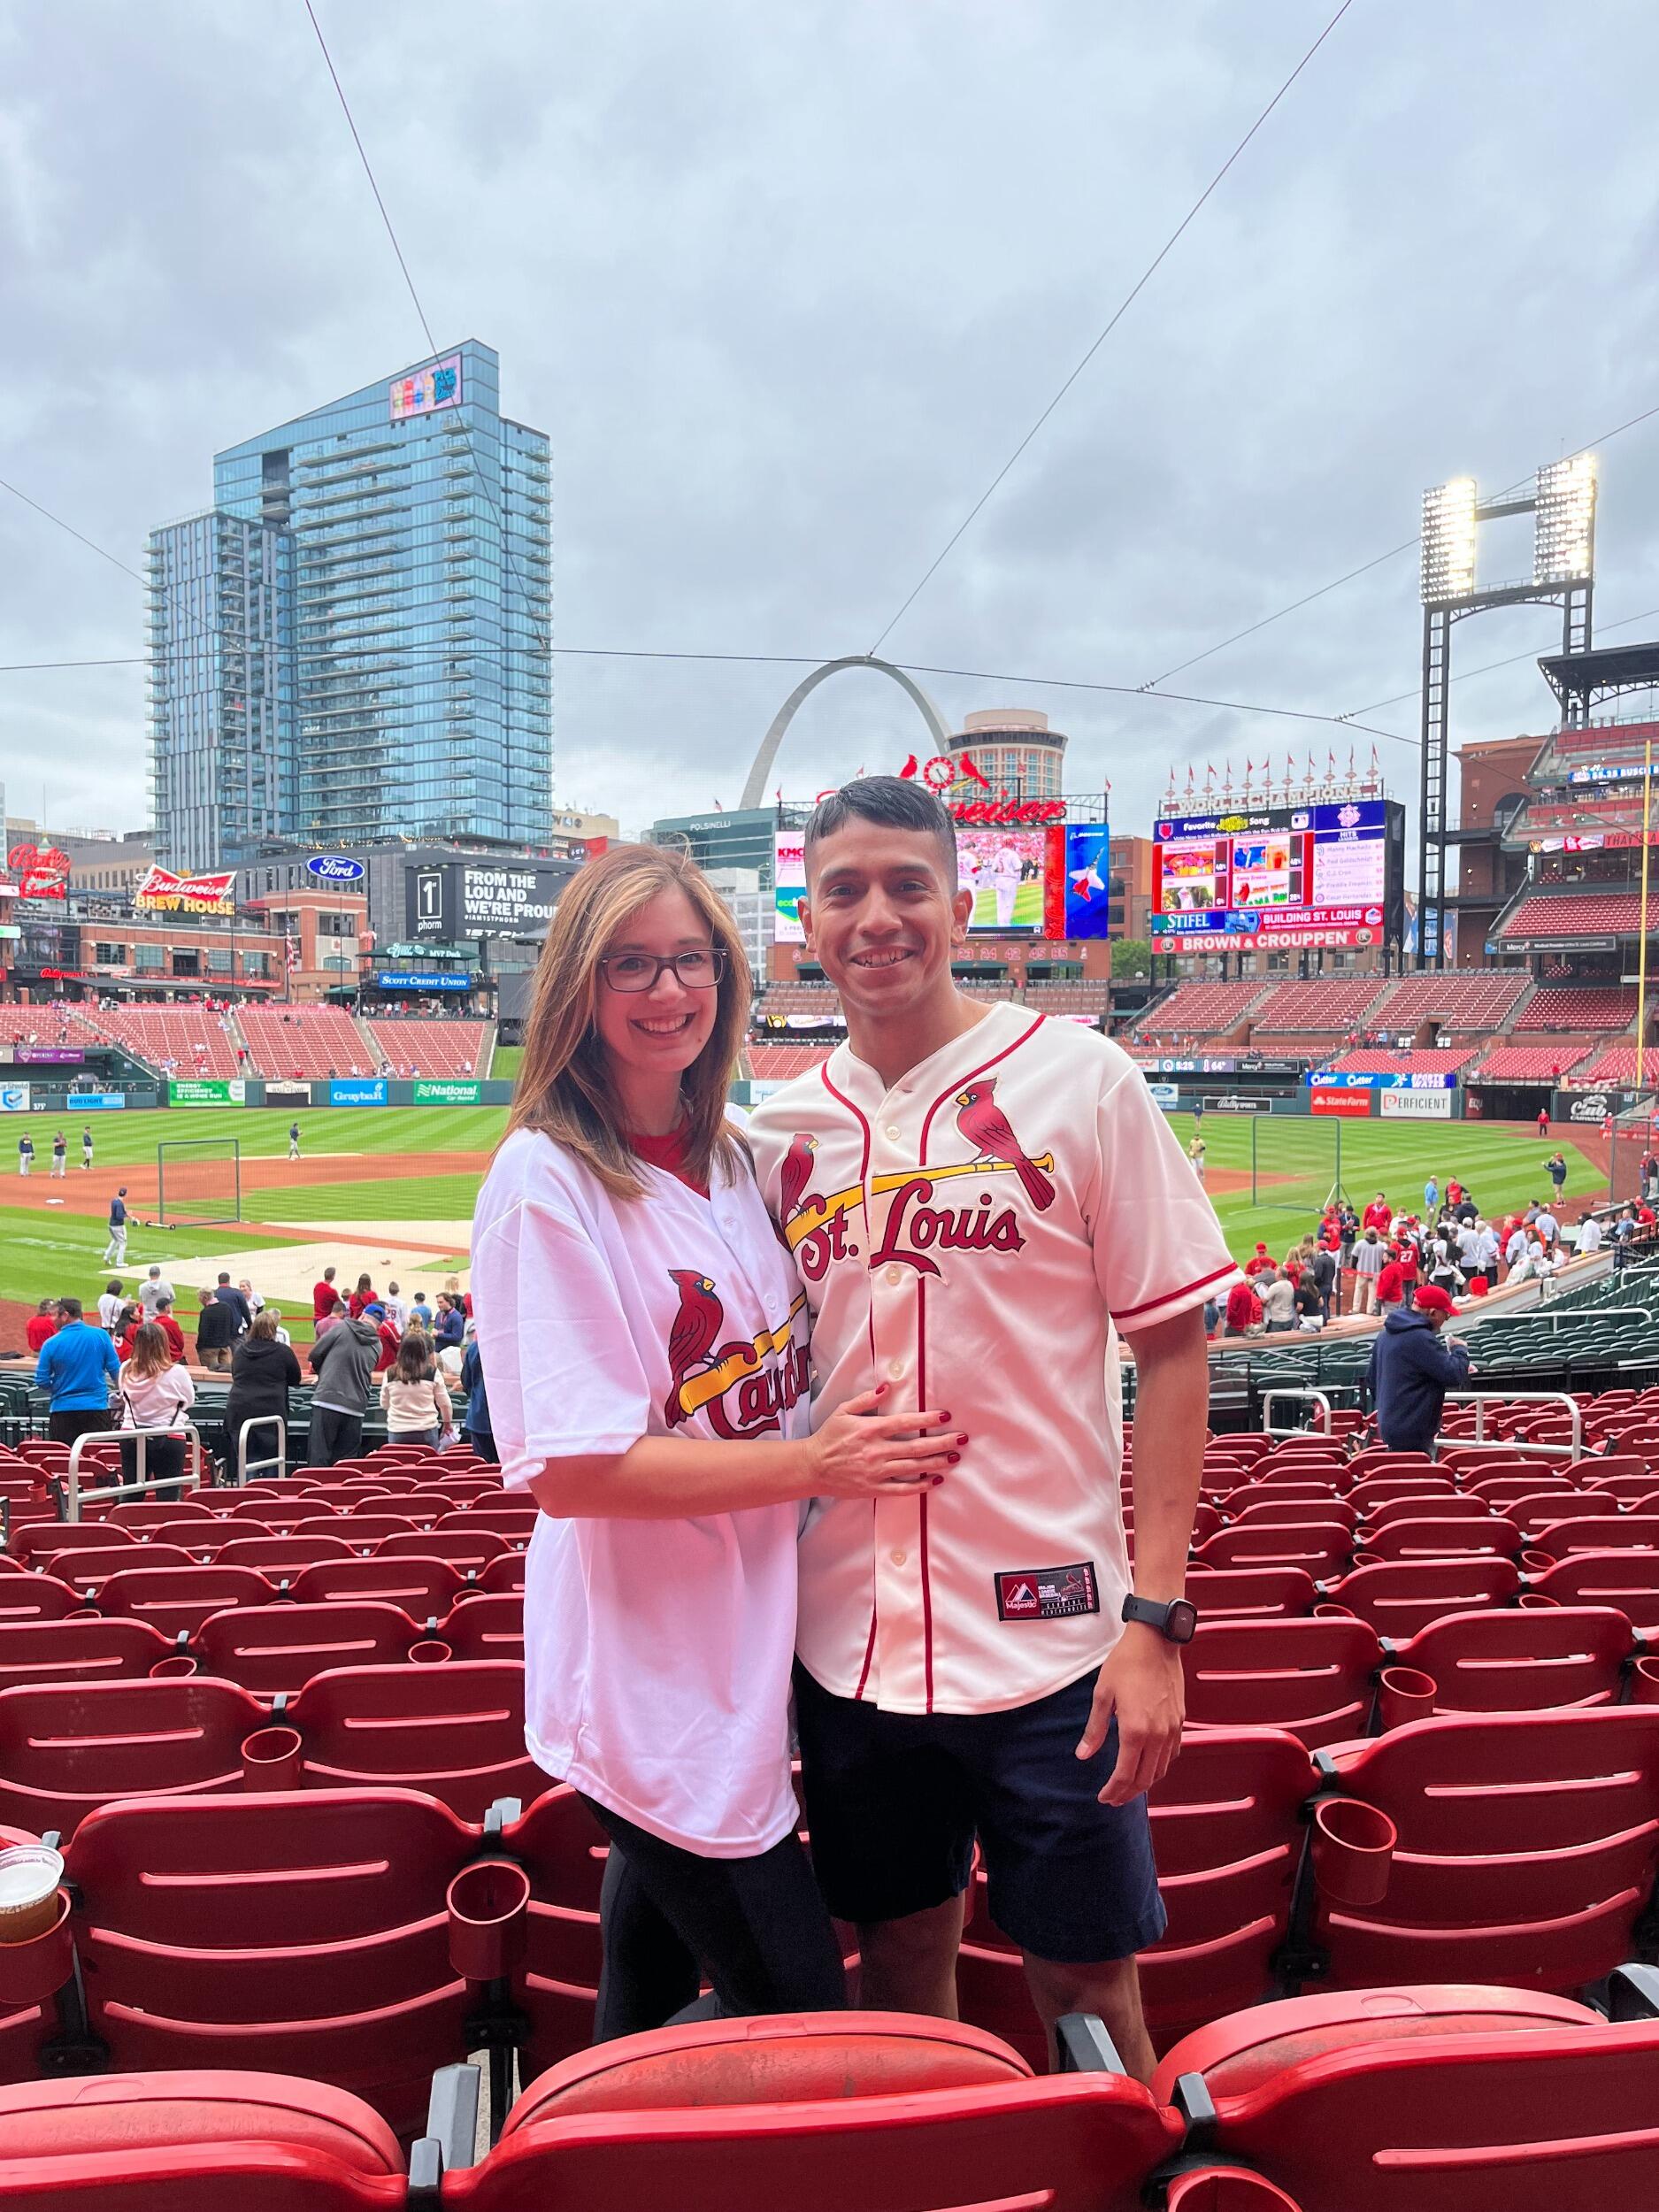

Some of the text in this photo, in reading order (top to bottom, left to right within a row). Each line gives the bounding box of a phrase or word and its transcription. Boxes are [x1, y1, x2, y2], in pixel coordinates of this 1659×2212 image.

[1178, 784, 1361, 812] WORLD CHAMPIONS
[690, 820, 731, 831] POLSINELLI
[1183, 821, 1217, 832] Favorite
[1249, 817, 1270, 826] Song
[1607, 833, 1643, 846] THAT'S
[1650, 833, 1657, 843] A
[319, 857, 354, 877] Ford
[136, 872, 234, 896] Budweiser
[465, 871, 536, 889] FROM THE
[465, 886, 526, 902] LOU AND
[136, 895, 234, 915] BREW HOUSE
[465, 900, 511, 917] WE'RE
[1167, 913, 1210, 929] STIFEL
[1263, 910, 1362, 924] BUILDING ST. LOUIS
[419, 920, 442, 933] phorm
[1183, 932, 1347, 950] BROWN & CROUPPEN
[957, 948, 973, 961] 23
[980, 948, 996, 961] 24
[1005, 948, 1021, 961] 42
[1029, 948, 1046, 961] 45
[382, 975, 408, 985] SCOTT
[441, 977, 467, 986] UNION
[1176, 1061, 1194, 1071] 5:25
[1310, 1074, 1337, 1086] Cutter
[1347, 1074, 1373, 1086] Cutter
[431, 1085, 477, 1095] National
[1383, 1094, 1447, 1110] PERFICIENT
[1571, 1102, 1607, 1117] Club
[801, 1179, 1025, 1281] St. Louis
[1401, 1250, 1414, 1263] 27
[1006, 1601, 1037, 1610] Majestic
